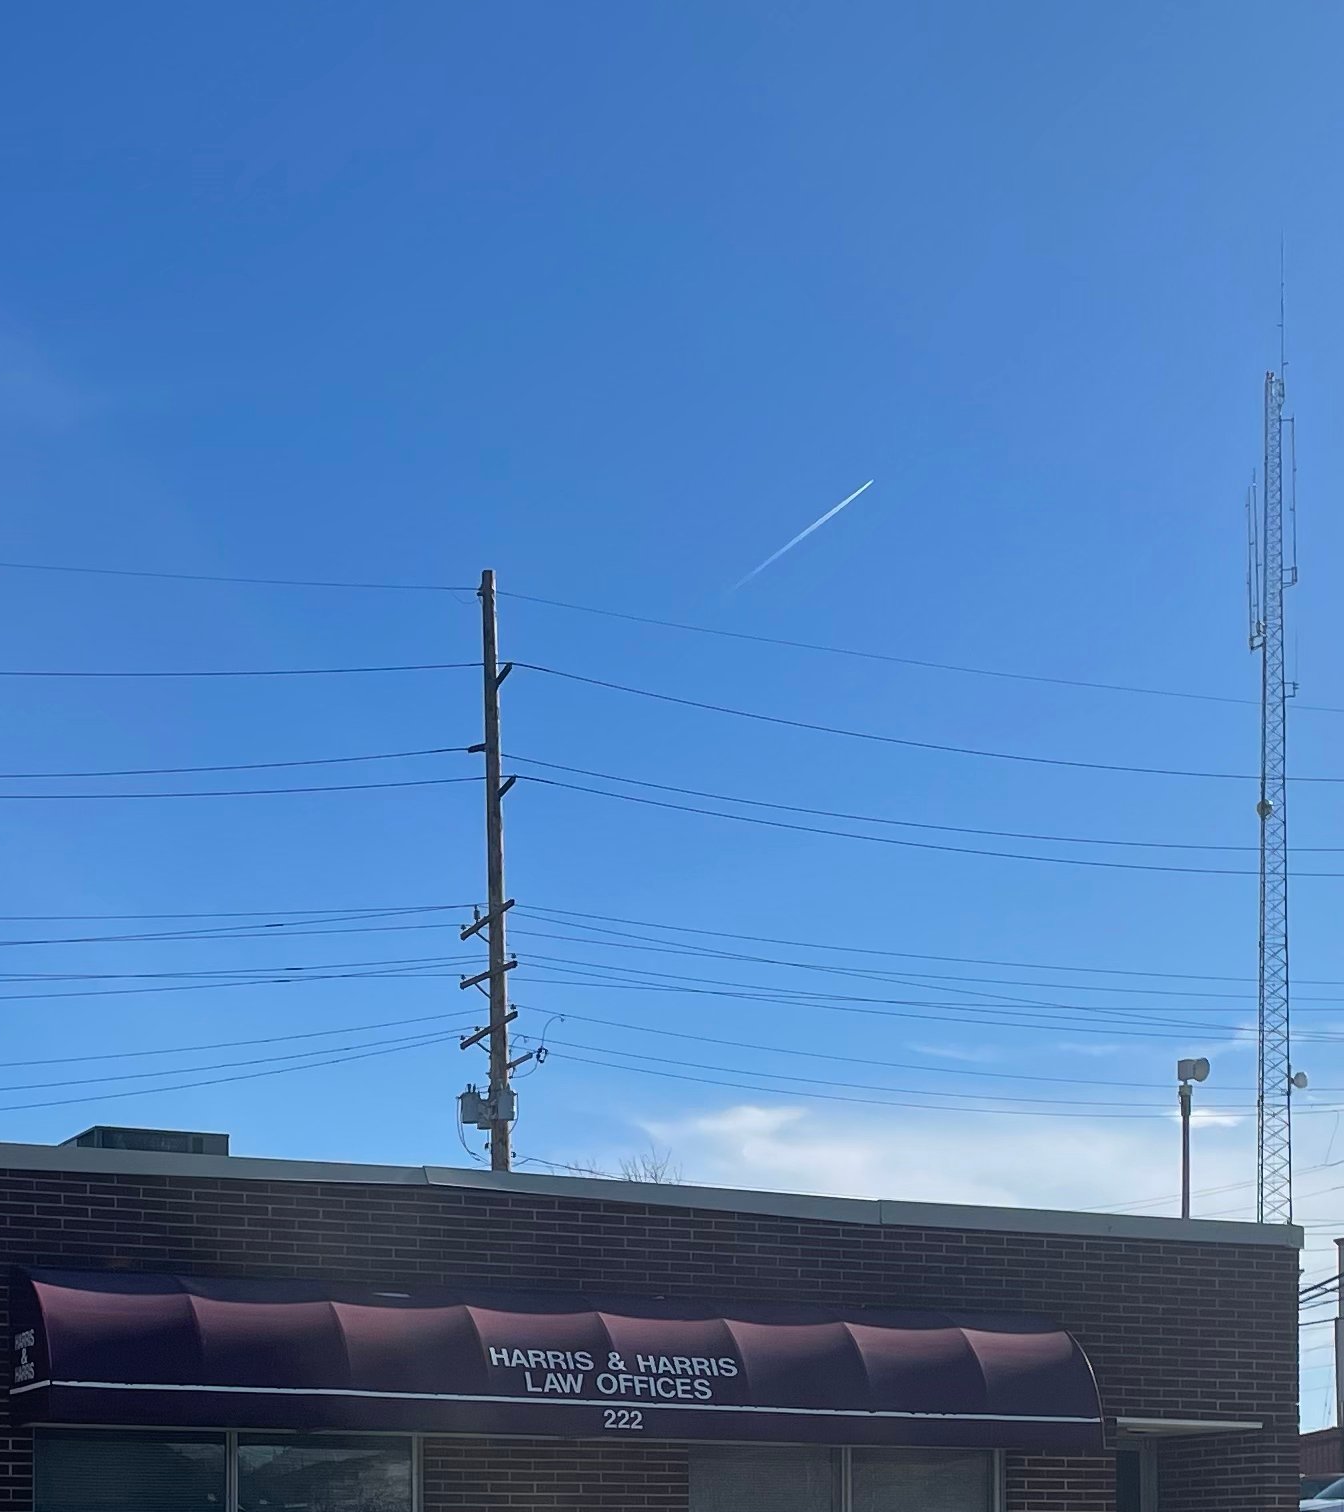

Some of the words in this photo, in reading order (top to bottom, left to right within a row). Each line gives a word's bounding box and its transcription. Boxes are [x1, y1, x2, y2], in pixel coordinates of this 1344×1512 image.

[489, 1346, 595, 1371] HARRIS
[607, 1352, 627, 1371] &
[636, 1354, 739, 1377] HARRIS
[524, 1371, 584, 1394] LAW
[596, 1373, 713, 1400] OFFICES
[603, 1409, 644, 1430] 222
